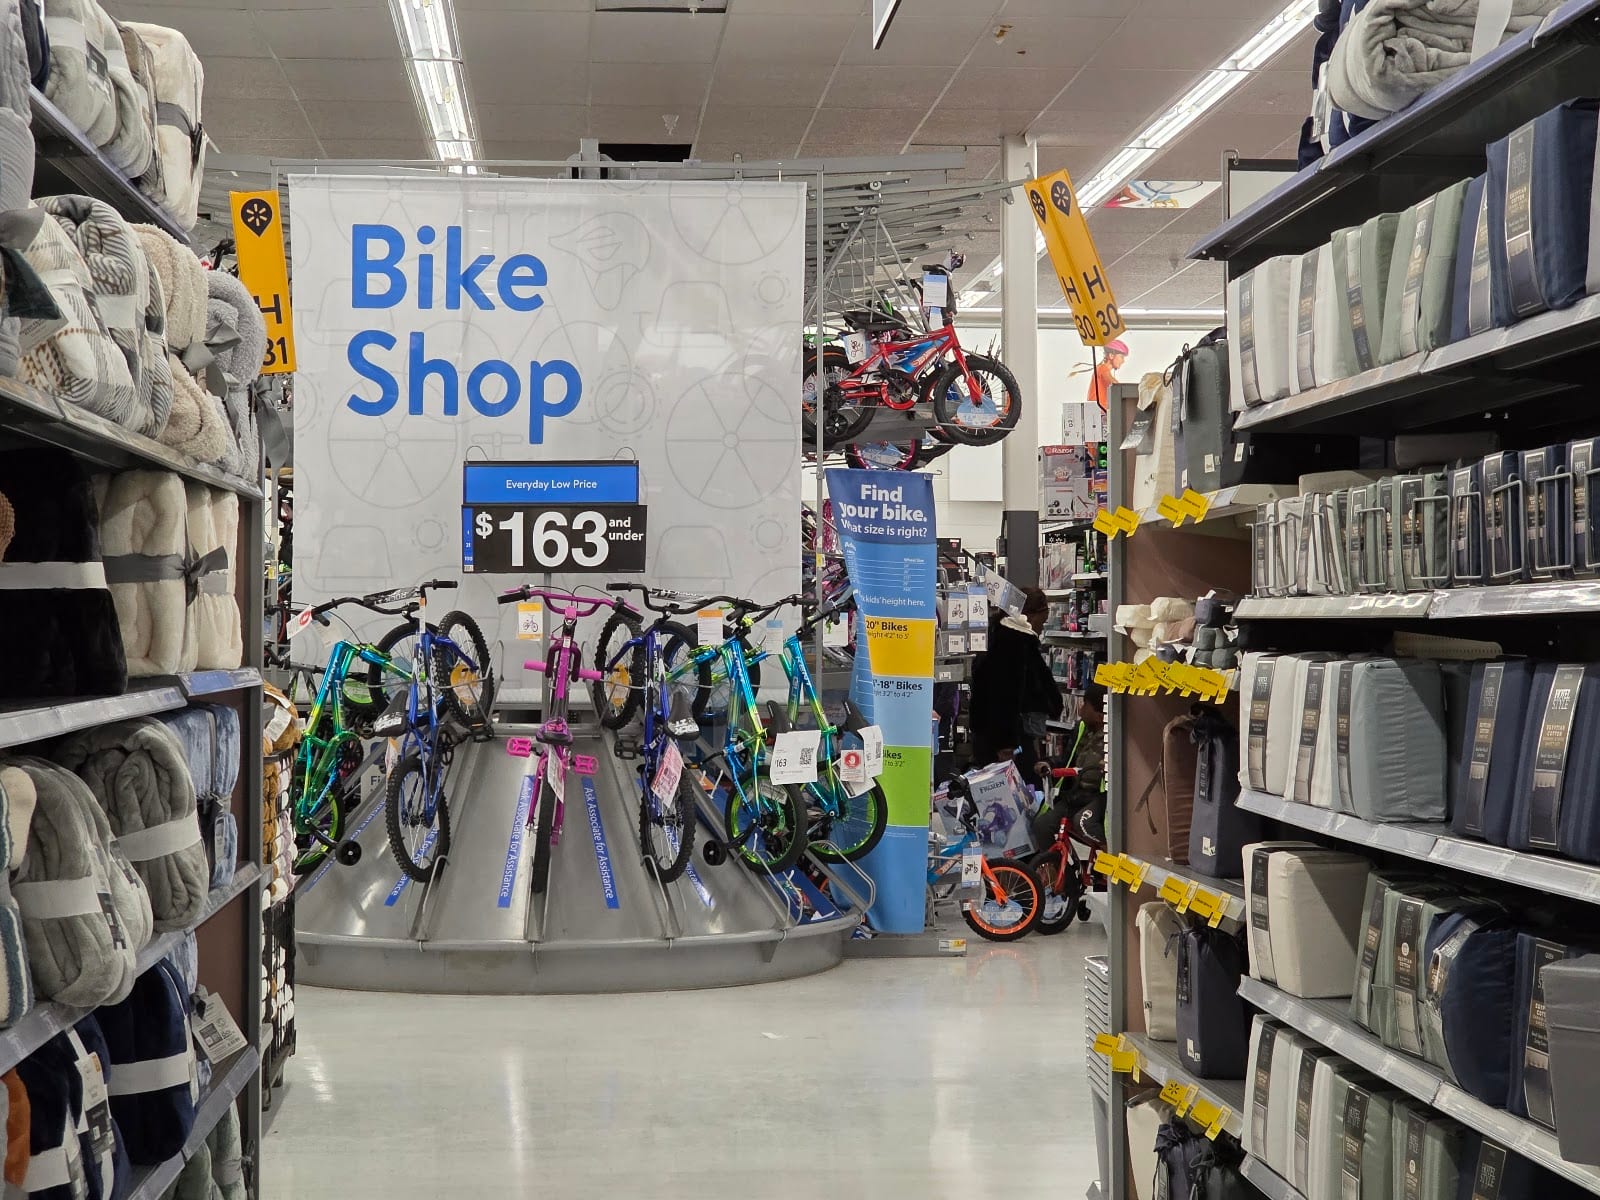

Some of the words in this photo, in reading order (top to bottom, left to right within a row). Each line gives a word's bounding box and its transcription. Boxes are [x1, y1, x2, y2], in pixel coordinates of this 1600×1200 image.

[351, 223, 548, 311] Bike
[1061, 276, 1081, 304] H
[1083, 265, 1106, 299] H
[254, 294, 282, 324] H
[1075, 314, 1096, 340] 30
[1096, 303, 1120, 337] 30
[347, 330, 583, 445] Shop
[506, 480, 549, 491] Everyday
[551, 480, 571, 489] Low
[573, 480, 598, 489] Price
[860, 484, 903, 502] Find
[609, 517, 632, 528] and
[838, 502, 878, 518] your
[882, 504, 927, 522] bike.
[609, 531, 645, 541] under
[840, 518, 862, 534] What
[864, 524, 884, 535] size
[886, 525, 895, 536] is
[897, 527, 928, 539] right?
[882, 597, 906, 606] height
[908, 598, 926, 607] here.
[881, 621, 908, 631] Bikes
[896, 680, 922, 691] Bikes
[584, 787, 594, 801] Ask
[513, 801, 529, 840] Associate
[587, 803, 602, 841] Associate
[511, 840, 521, 853] for
[596, 842, 605, 858] for
[501, 854, 518, 897] Assistance
[598, 855, 614, 899] Assistance
